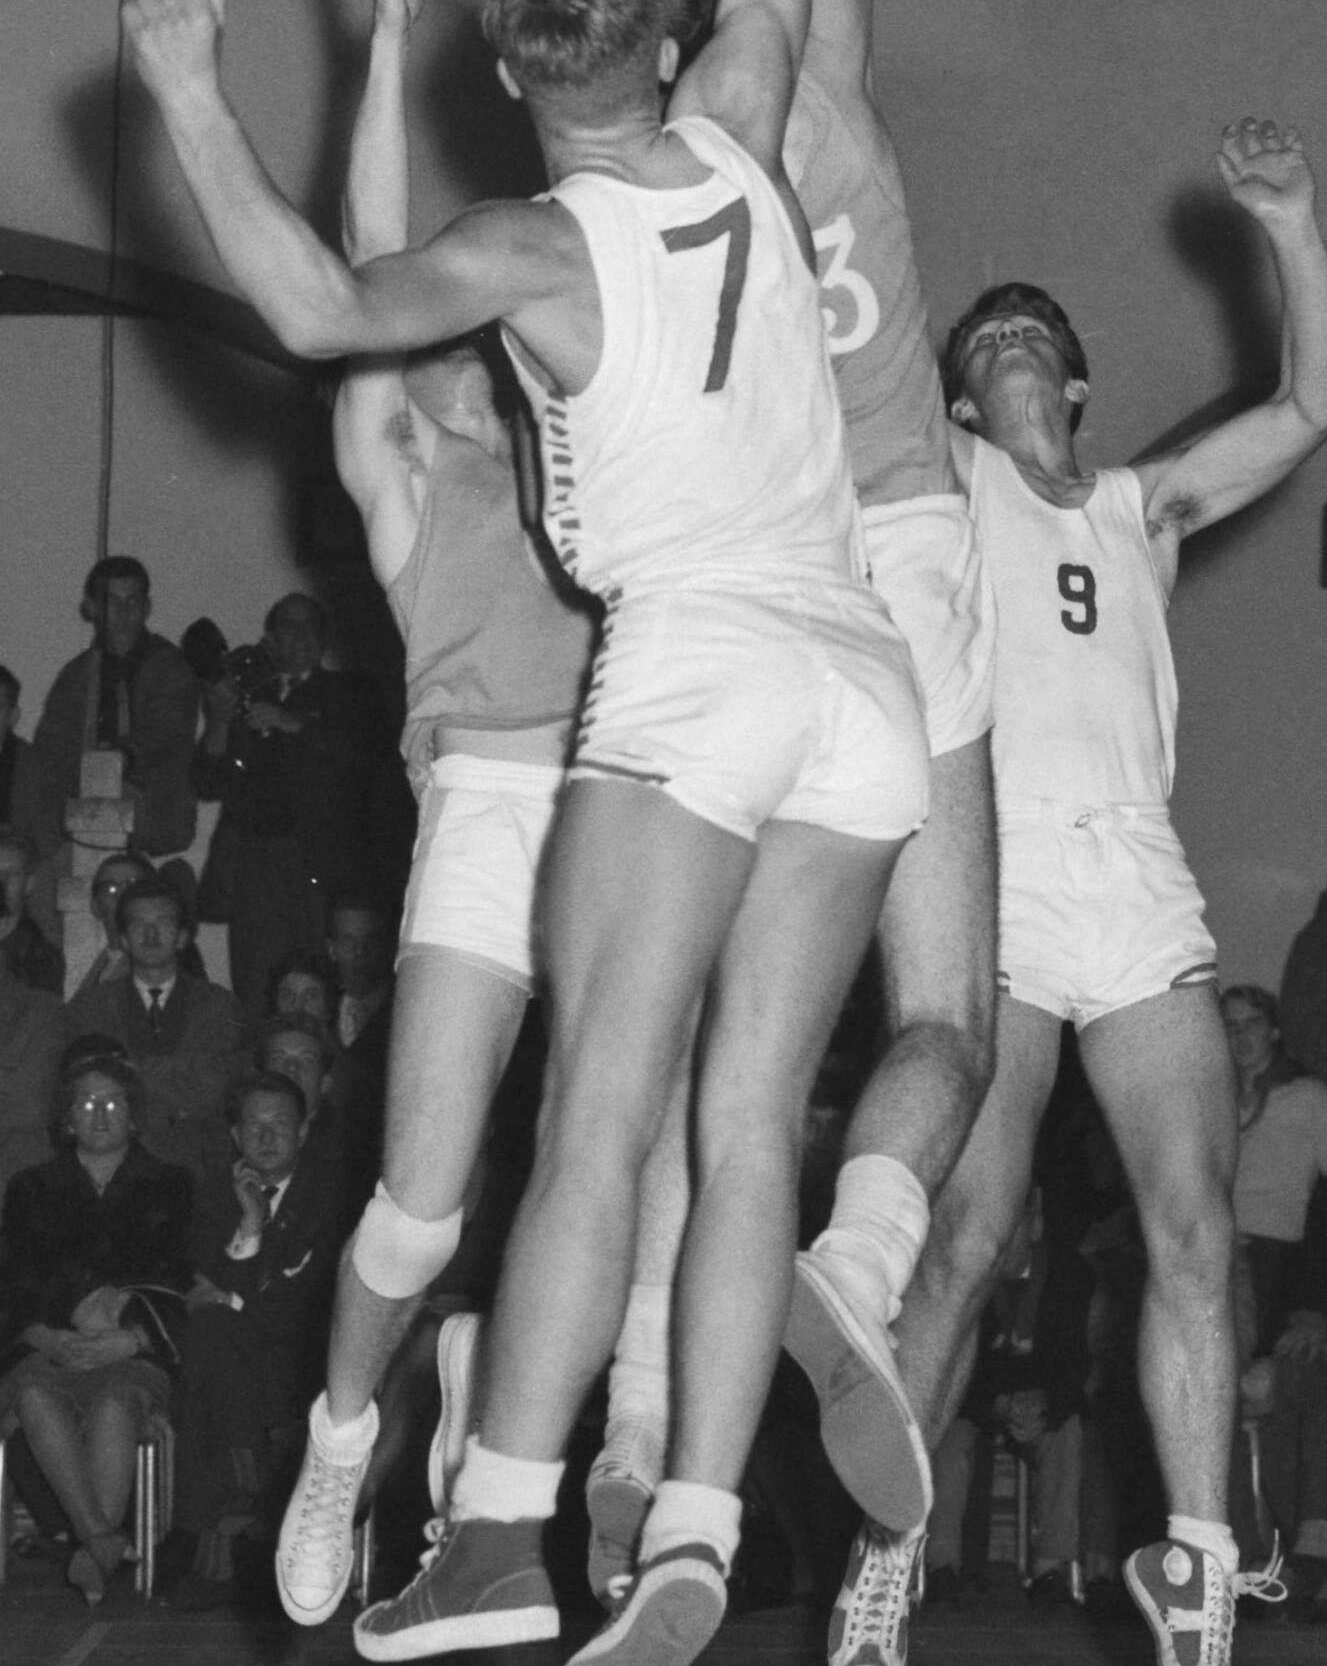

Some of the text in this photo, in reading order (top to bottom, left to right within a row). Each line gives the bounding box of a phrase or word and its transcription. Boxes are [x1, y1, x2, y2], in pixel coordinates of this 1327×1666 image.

[659, 195, 753, 394] 7
[812, 214, 880, 355] 3
[1057, 562, 1098, 636] 9
